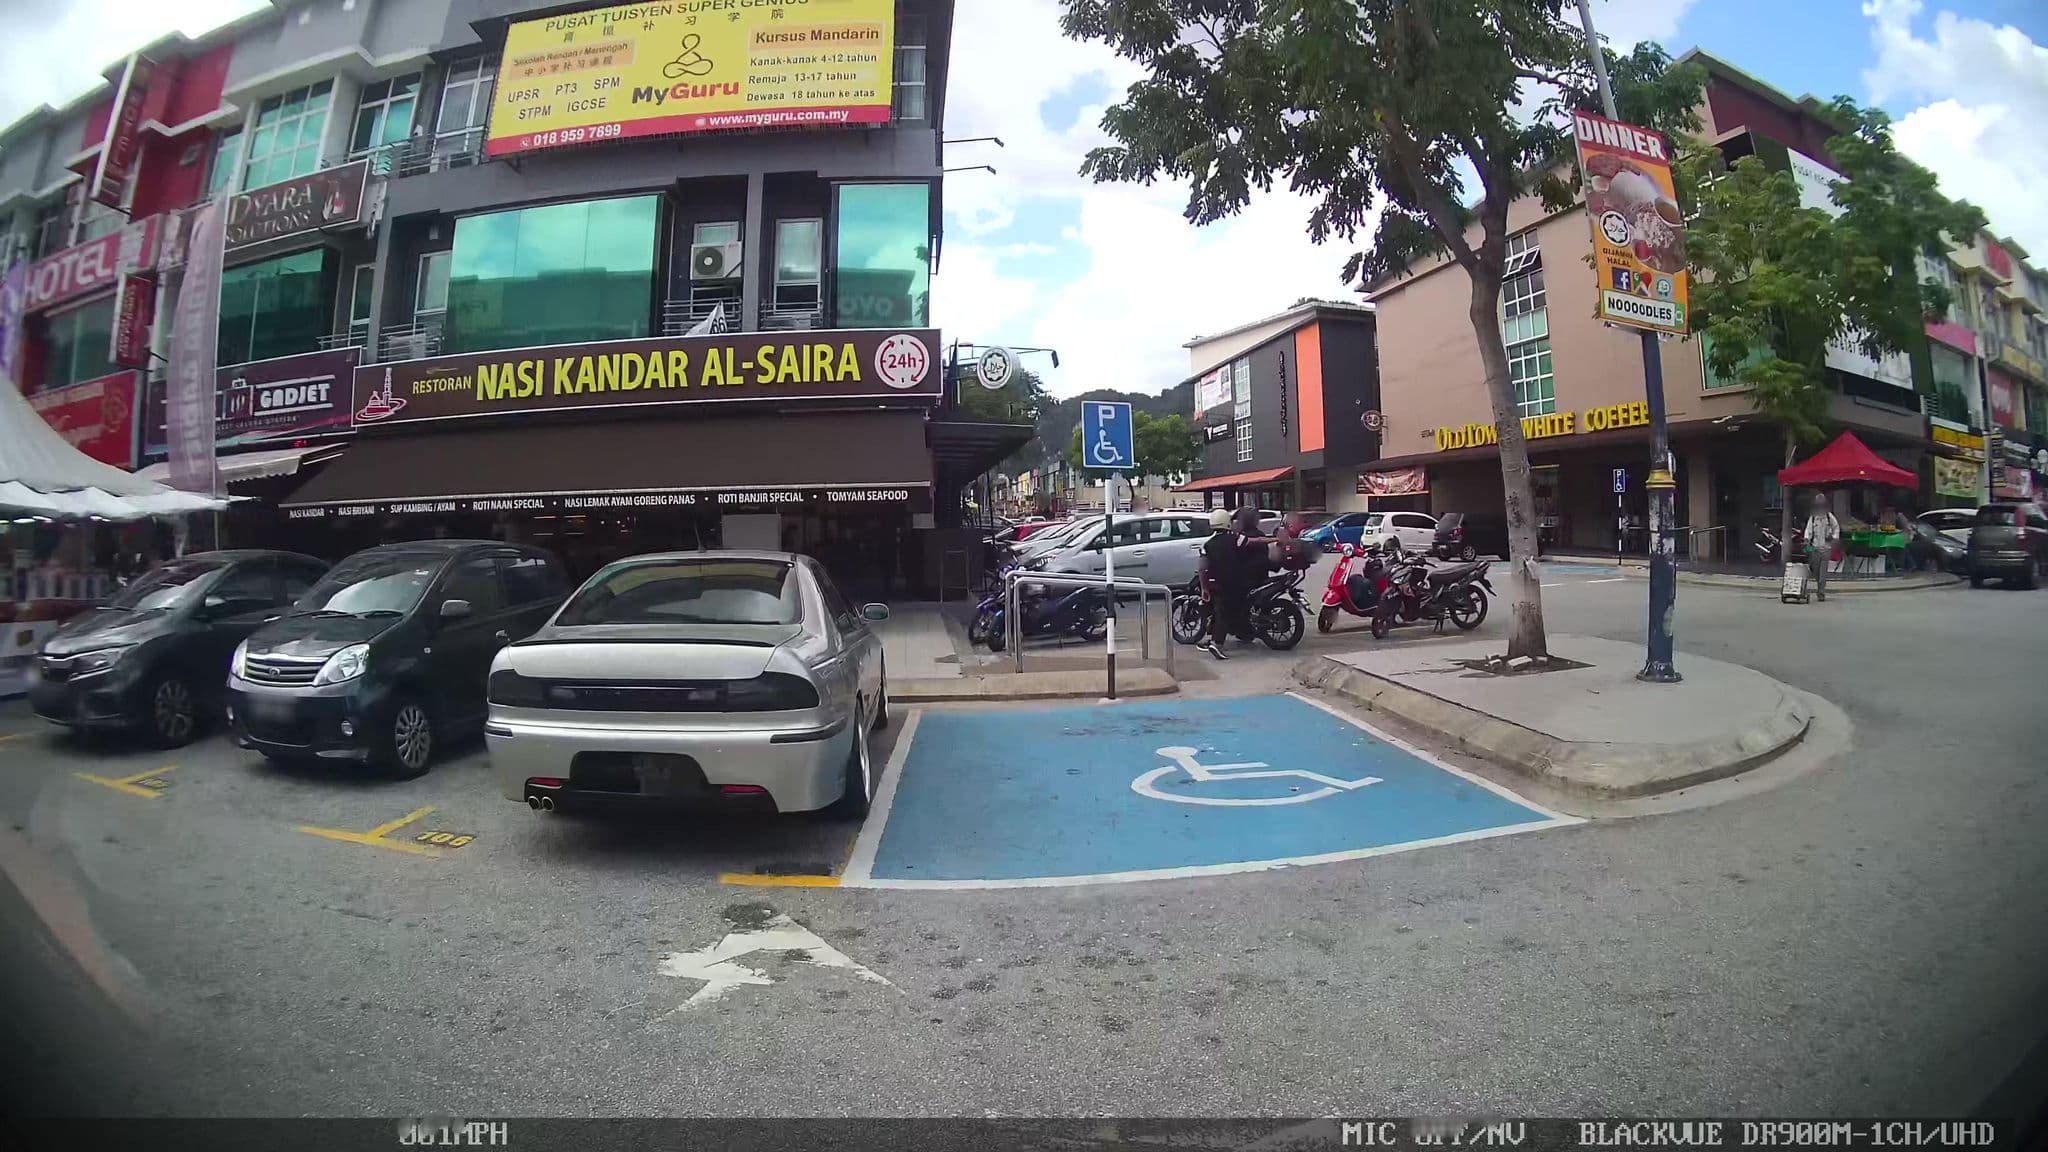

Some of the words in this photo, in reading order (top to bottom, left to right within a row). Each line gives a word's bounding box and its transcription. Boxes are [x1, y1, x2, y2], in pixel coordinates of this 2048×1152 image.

[546, 14, 598, 32] PUSAT
[602, 4, 672, 24] TUISYEN
[677, 0, 735, 14] SUPER
[756, 31, 806, 44] Kursus
[810, 27, 880, 42] Mandarin
[750, 56, 818, 67] Kanak-kanak
[821, 54, 844, 63] 4-12
[847, 54, 878, 62] tahun
[748, 74, 787, 85] Remaja
[794, 73, 822, 82] 13-17
[826, 72, 857, 81] tahun
[508, 88, 540, 103] UPSR
[555, 83, 578, 95] PT3
[594, 77, 620, 90] SPM
[632, 82, 740, 106] MyGuru
[746, 92, 786, 102] Dewasa
[792, 91, 803, 100] 18
[806, 90, 835, 99] tahun
[838, 90, 850, 98] ke
[853, 90, 876, 98] atas
[518, 105, 552, 120] STPM
[567, 97, 606, 112] IGCSE
[709, 109, 849, 126] www.myguru.com.my
[533, 132, 557, 146] 018
[560, 128, 585, 142] 959
[588, 124, 622, 139] 7899
[1576, 116, 1666, 160] DINNER
[22, 241, 113, 304] HOTEL
[1608, 296, 1672, 320] NOOOODLES
[412, 375, 472, 395] RESTORAN
[476, 359, 544, 400] NASI
[554, 350, 688, 395] KANDAR
[700, 343, 862, 386] AL-SAIRA
[888, 352, 917, 370] 24h
[260, 383, 331, 408] GADJET
[1098, 405, 1116, 427] P
[1435, 422, 1499, 451] OLDTOW
[1521, 411, 1576, 440] WHITE
[1584, 400, 1650, 432] COFFEE
[472, 501, 490, 511] ROTI
[490, 500, 512, 510] NAAN
[513, 498, 544, 510] SPECIAL
[564, 498, 583, 508] NASI
[584, 497, 610, 507] LEMAK
[610, 496, 633, 506] AYAM
[634, 495, 668, 506] GORENG
[668, 494, 696, 505] PANAS
[718, 494, 738, 504] ROTI
[738, 492, 769, 504] BANJIR
[769, 492, 804, 502] SPECIAL
[826, 491, 866, 502] TOMYAM
[866, 490, 909, 500] SEAFOOD
[390, 504, 402, 514] SUP
[403, 503, 433, 513] KAMBING
[438, 502, 456, 512] AYAM
